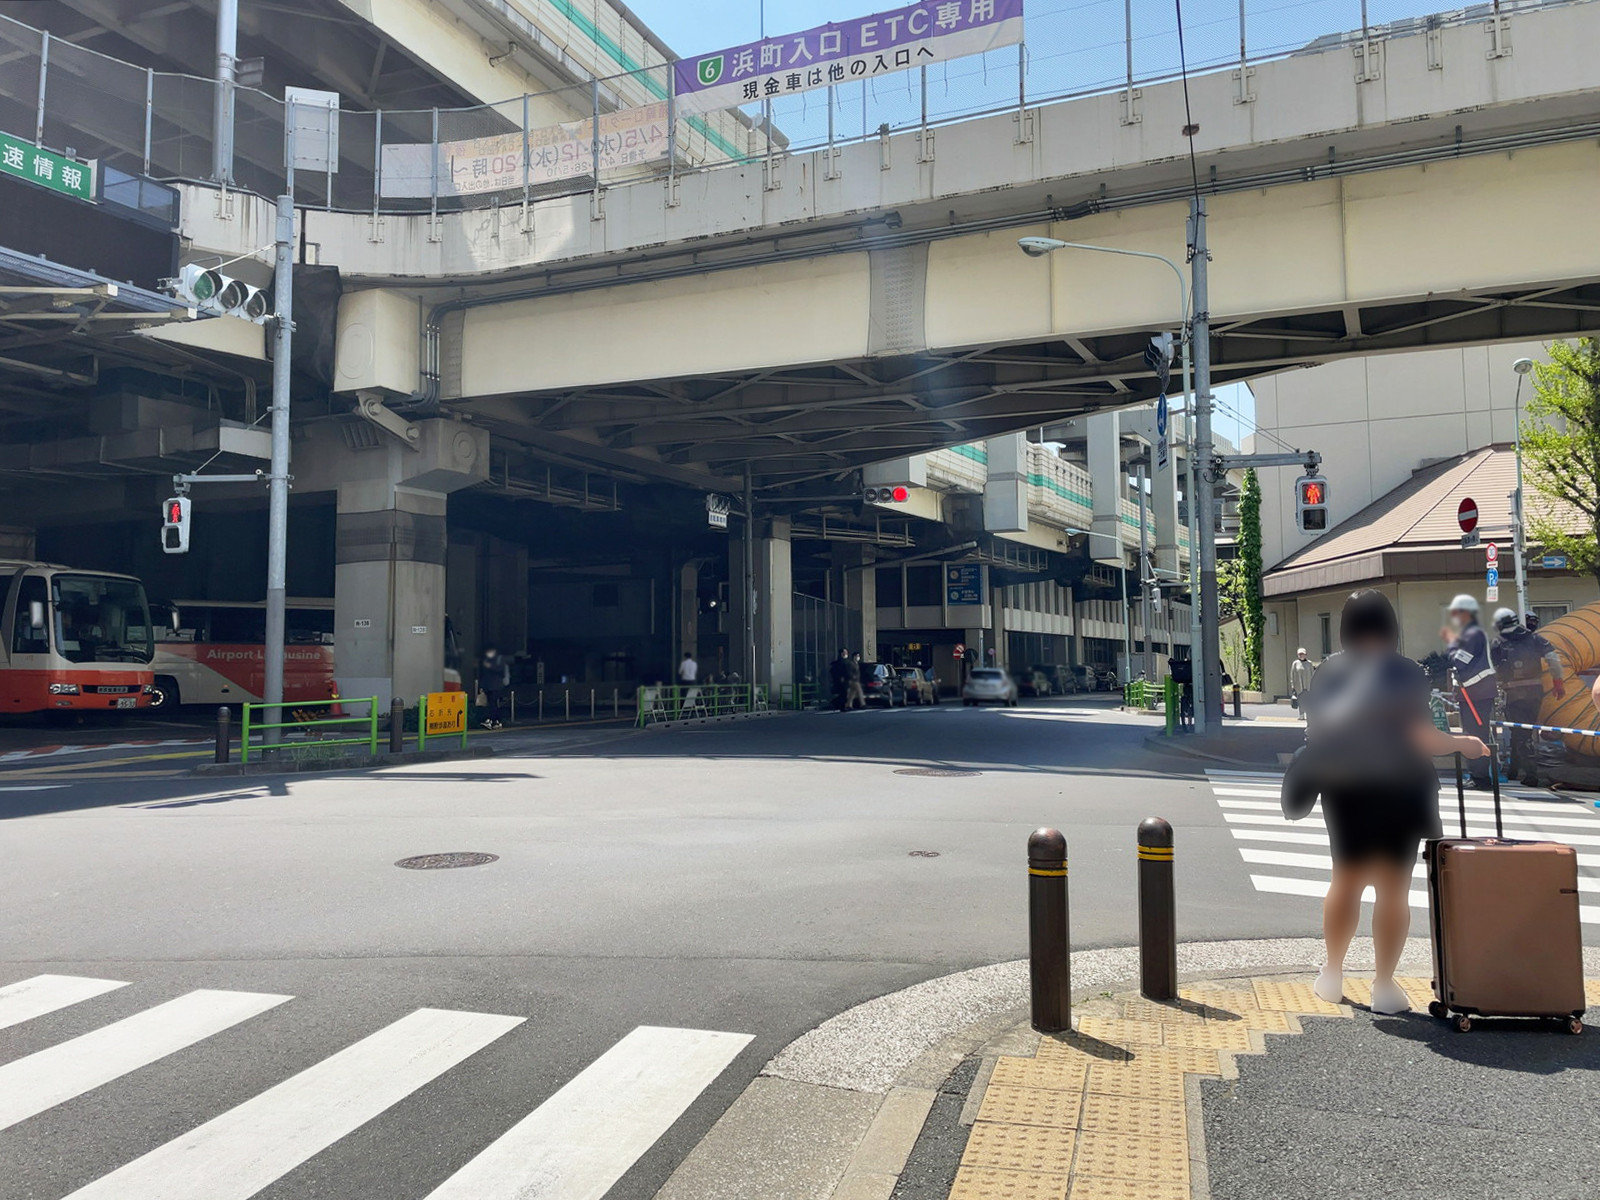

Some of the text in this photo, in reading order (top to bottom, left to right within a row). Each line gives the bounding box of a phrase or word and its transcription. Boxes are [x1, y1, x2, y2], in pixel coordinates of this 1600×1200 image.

[705, 62, 714, 78] 6
[731, 30, 841, 77] 浜町入口
[743, 47, 934, 99] 現金車は他の入口へ
[3, 144, 82, 191] 速情報
[207, 649, 321, 662] Airport Lusine
